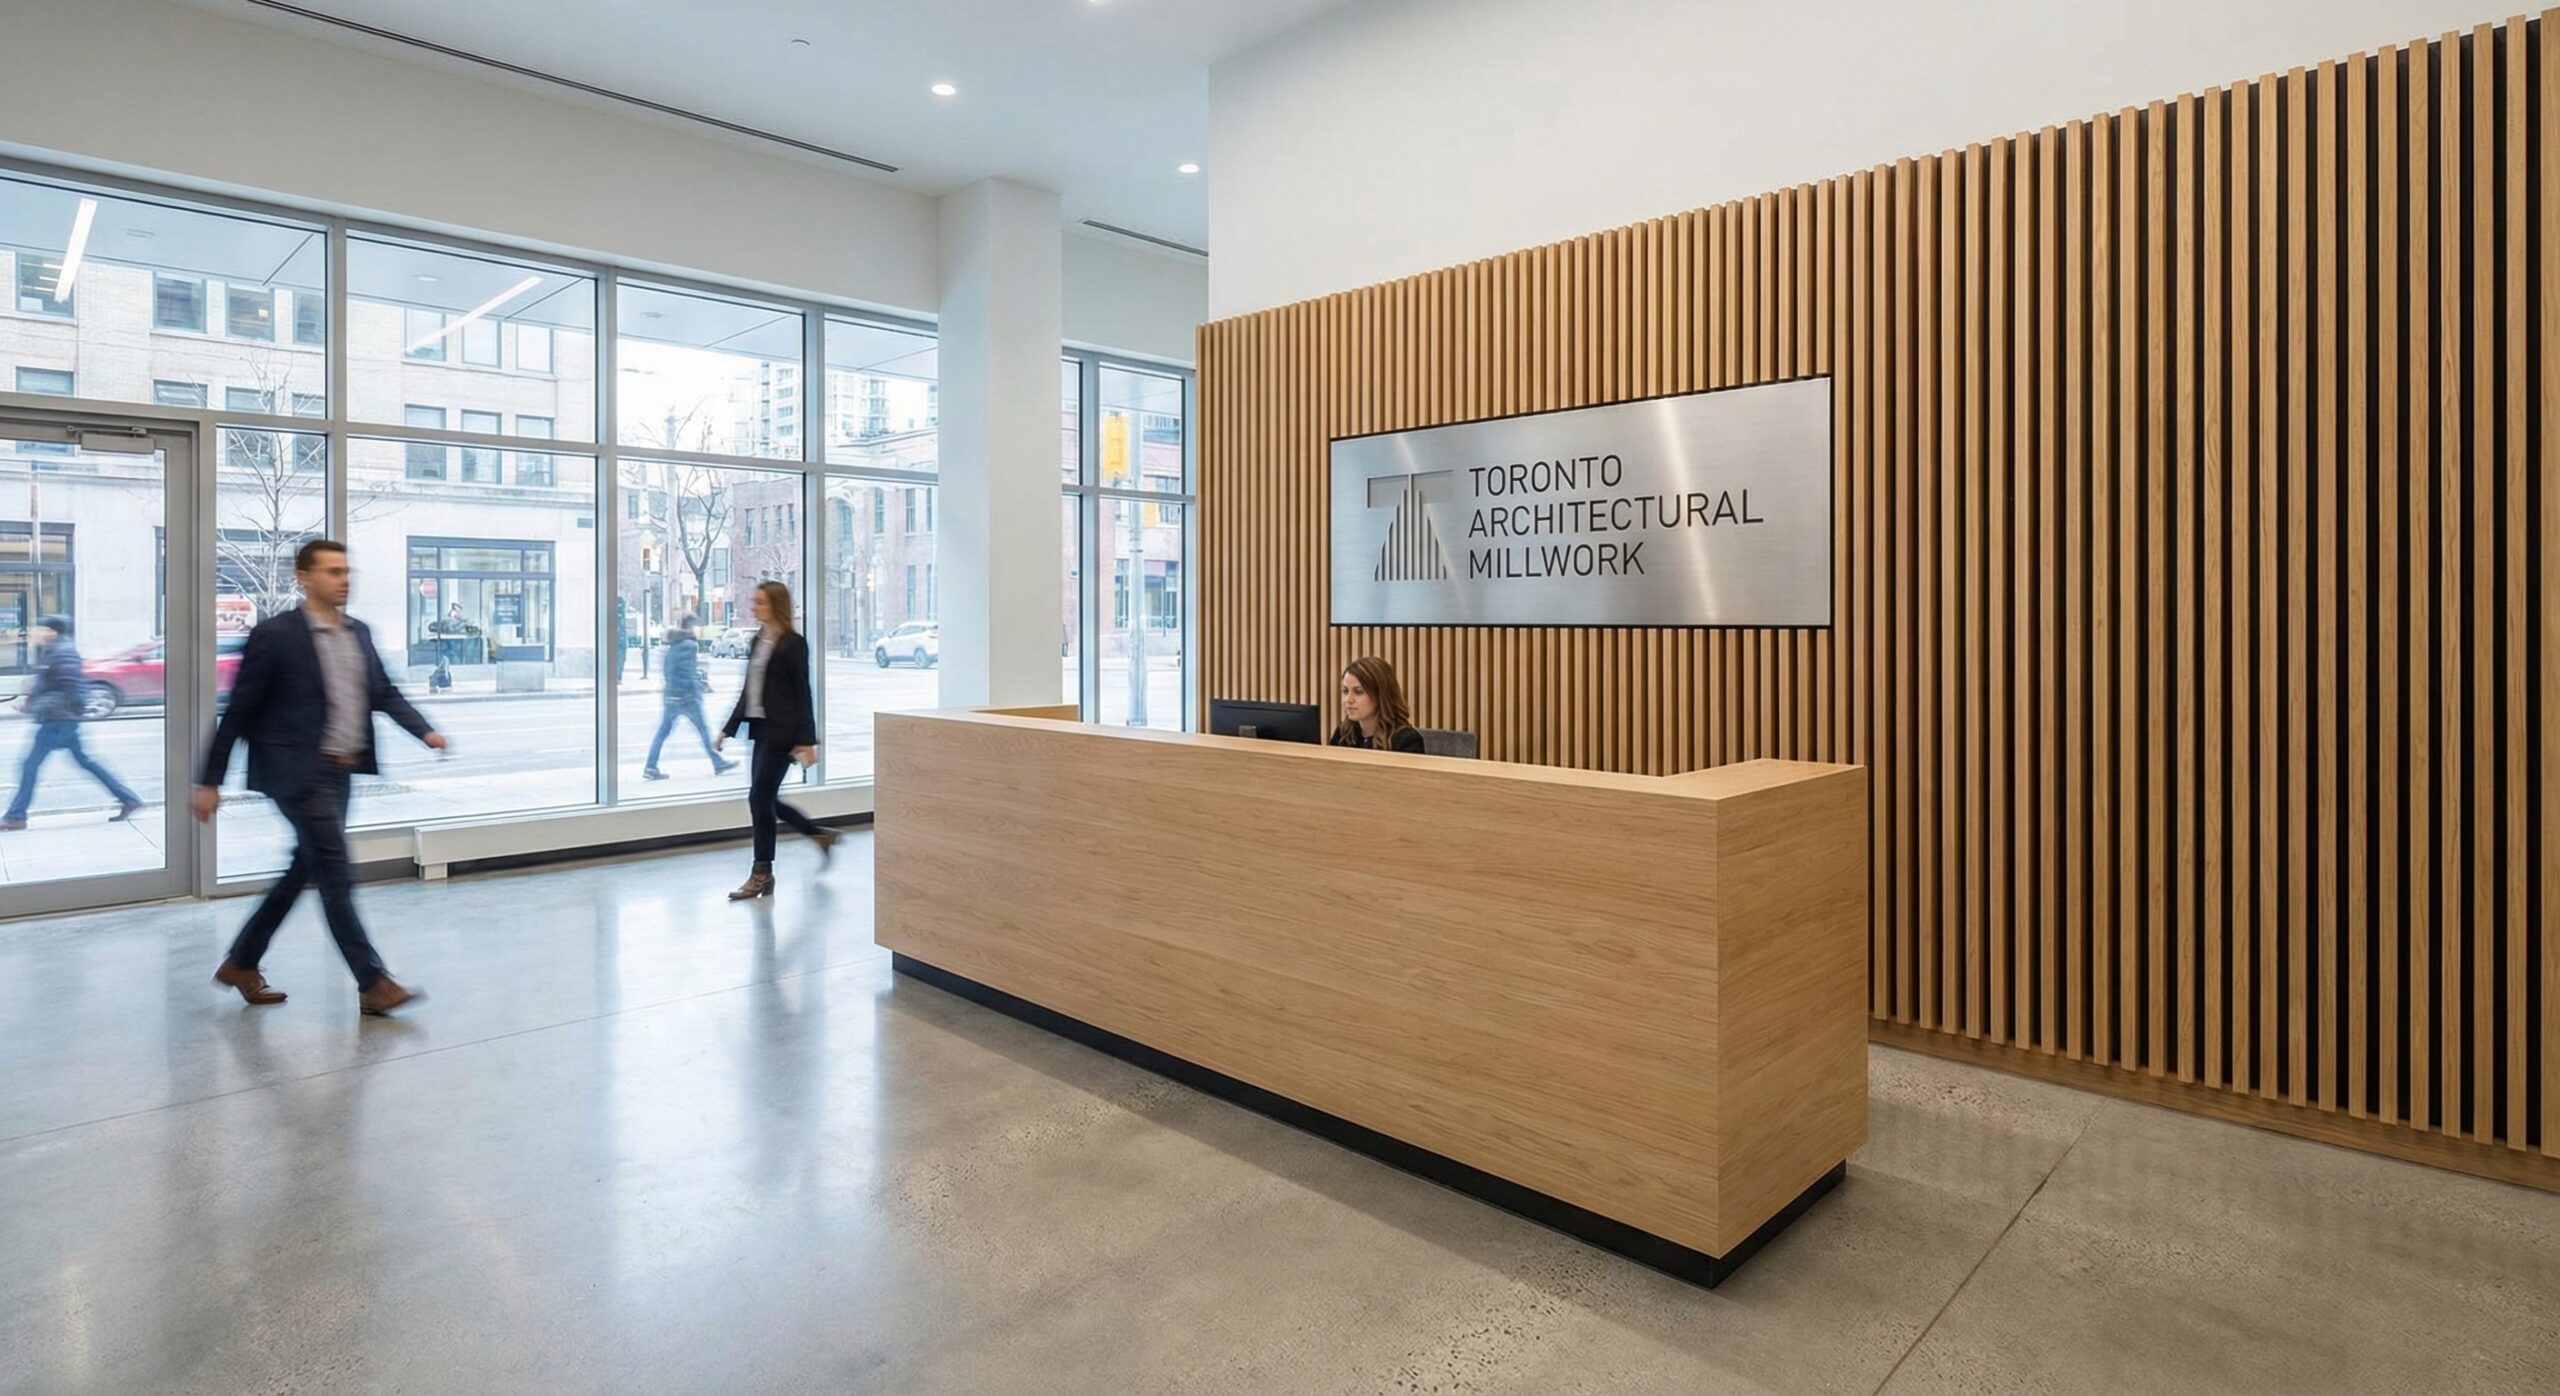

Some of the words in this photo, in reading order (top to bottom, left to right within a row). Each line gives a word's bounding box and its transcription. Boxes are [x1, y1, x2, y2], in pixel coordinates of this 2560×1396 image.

[1469, 454, 1622, 497] TORONTO
[1468, 488, 1764, 538] ARCHITECTURAL
[1469, 543, 1645, 580] MILLWORK
